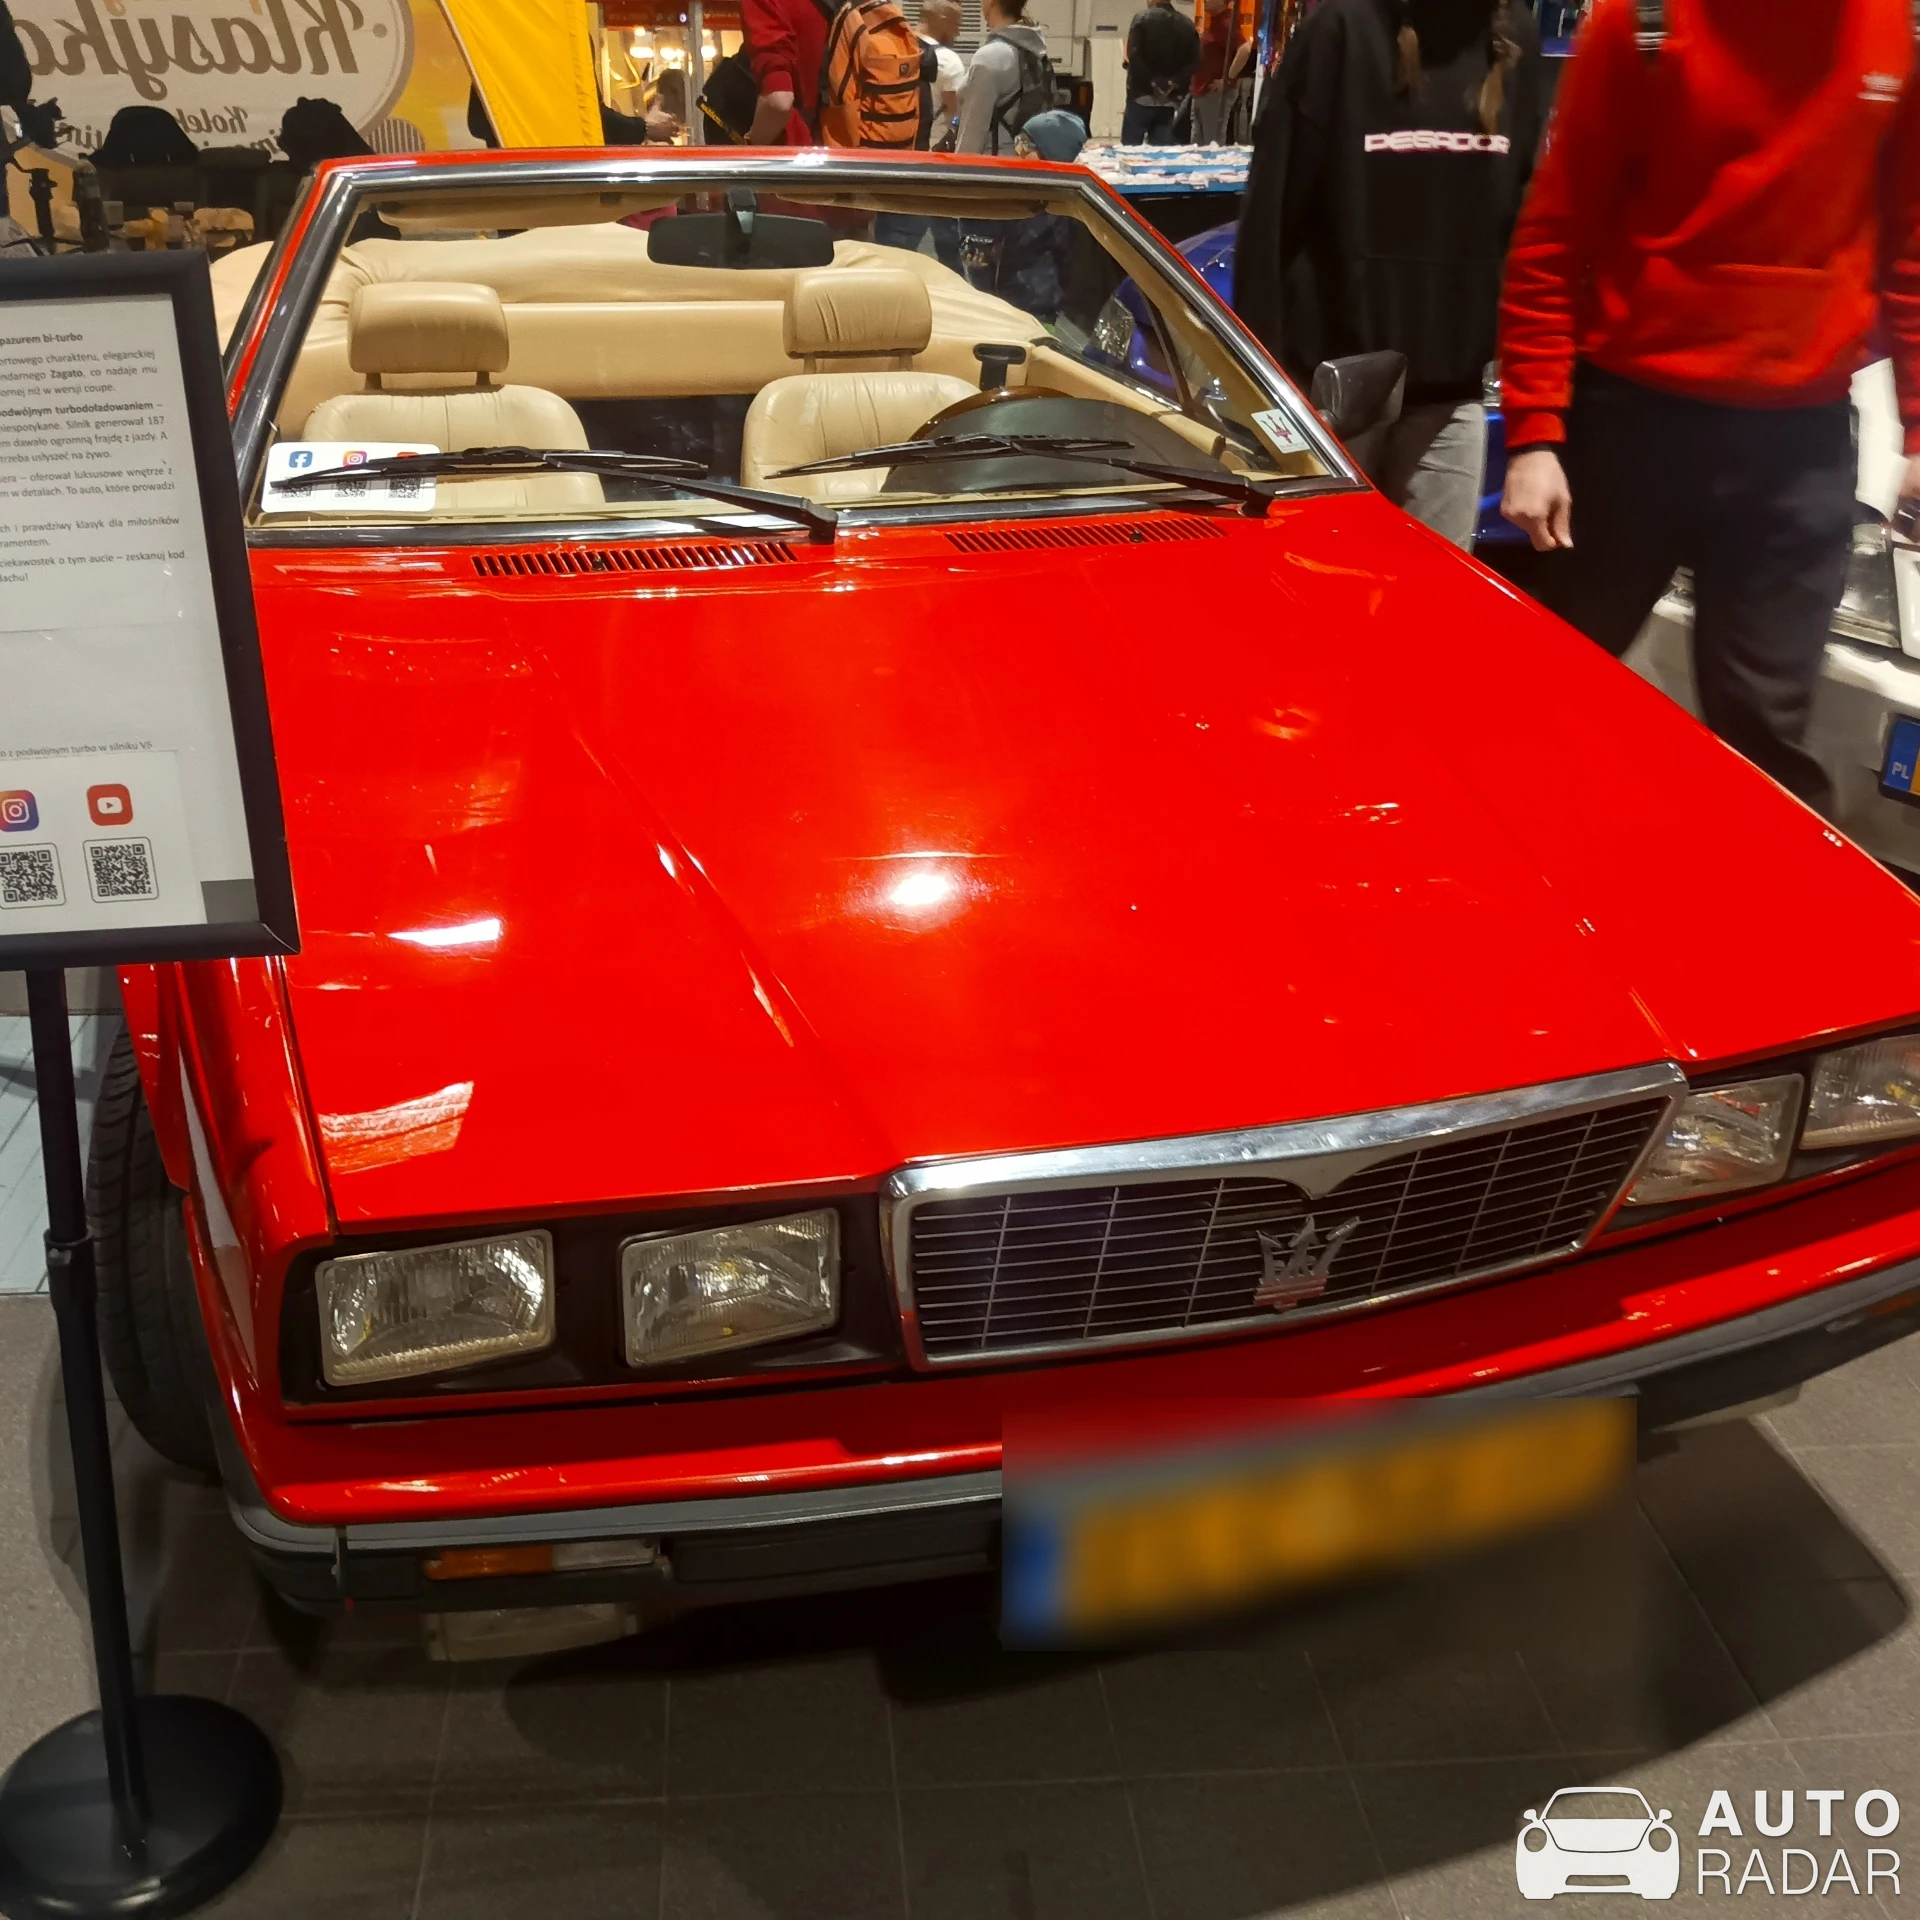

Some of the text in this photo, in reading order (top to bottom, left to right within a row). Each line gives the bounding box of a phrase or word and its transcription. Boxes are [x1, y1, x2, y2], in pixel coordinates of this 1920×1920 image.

[1364, 130, 1511, 154] PEGADOR
[0, 333, 83, 347] pazurem bi-turbo
[106, 366, 137, 378] nadaje
[142, 366, 157, 374] mu
[54, 385, 82, 396] wersji
[66, 418, 90, 430] Silnik
[148, 416, 164, 426] 187
[160, 431, 168, 440] A
[72, 452, 83, 460] na
[74, 468, 123, 480] luksusowe
[66, 486, 78, 495] To
[105, 484, 130, 494] które
[132, 481, 175, 493] prowadzi
[22, 521, 72, 534] prawdziwy
[76, 519, 104, 531] klasyk
[108, 519, 124, 528] dla
[58, 557, 65, 565] o
[68, 556, 86, 566] tym
[88, 553, 114, 563] aucie
[126, 551, 166, 563] zeskanuj
[168, 550, 185, 559] kod
[1891, 761, 1909, 780] PL
